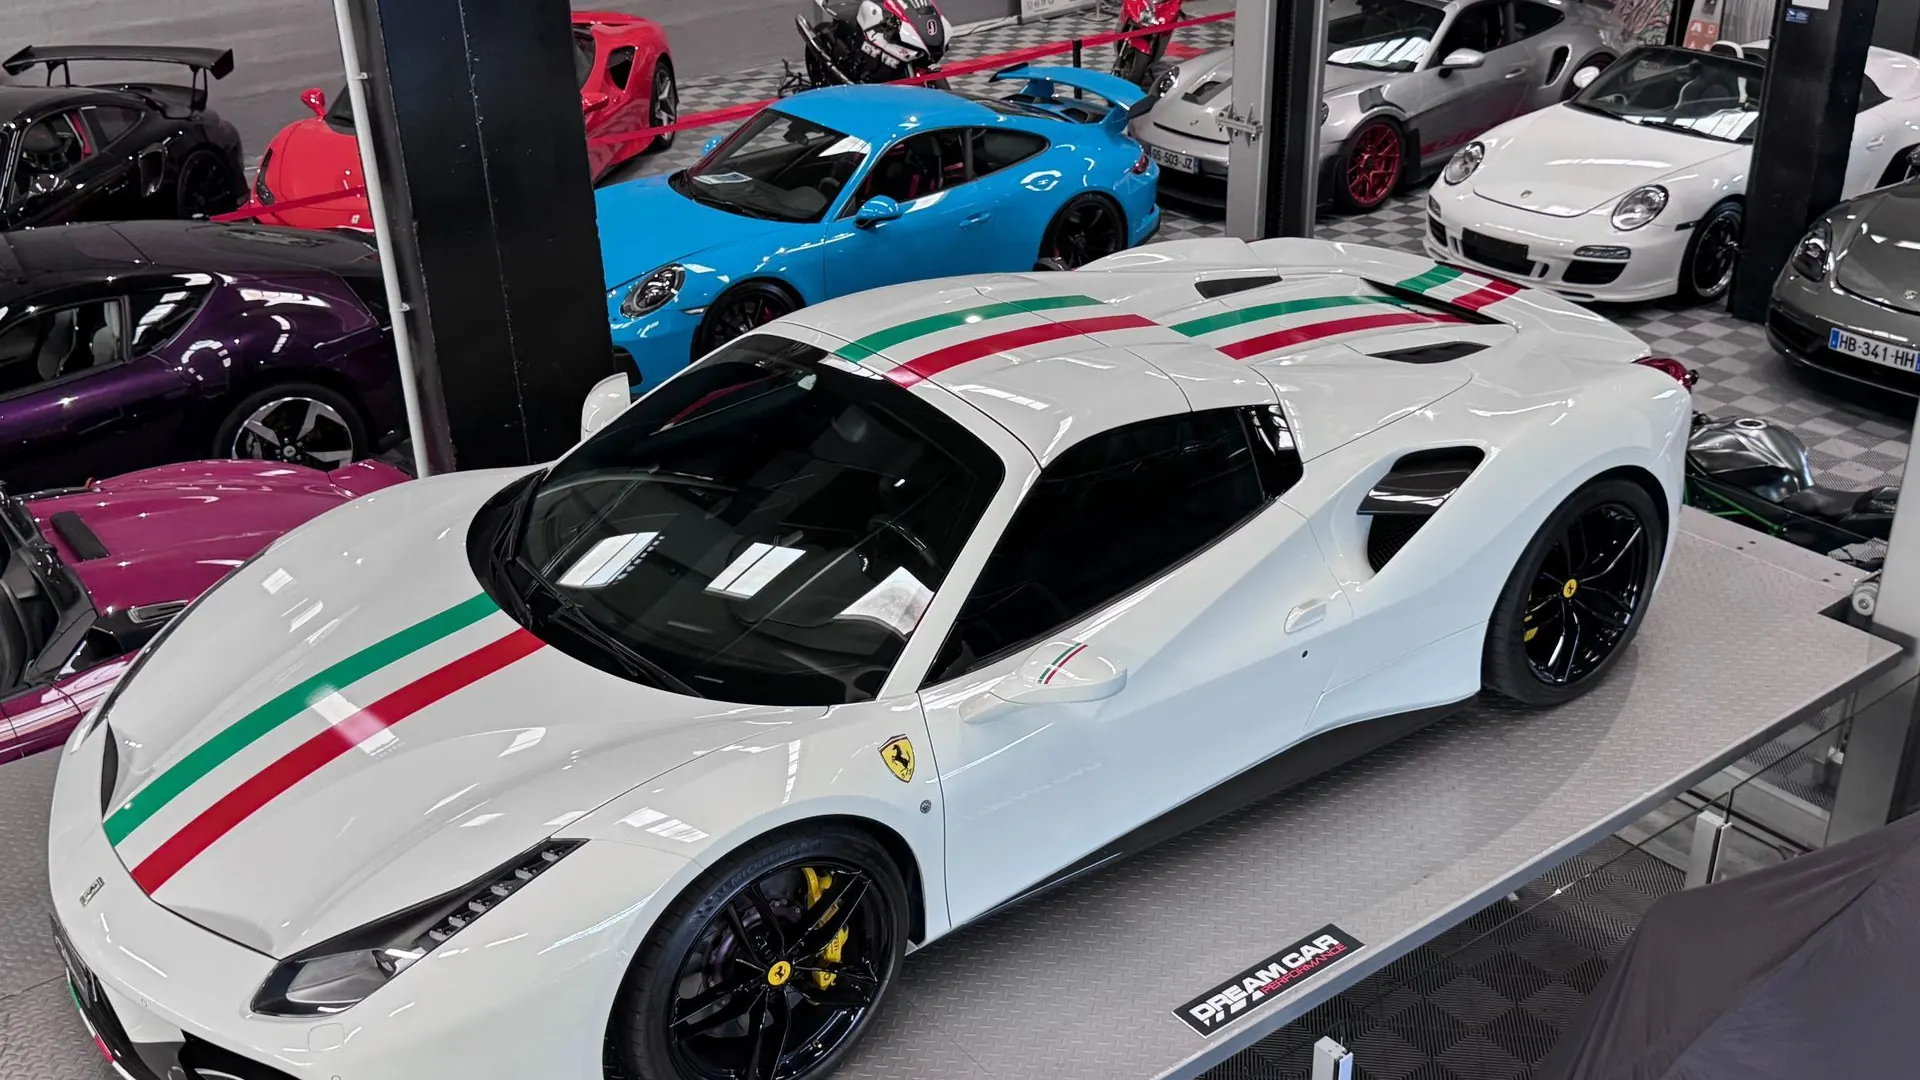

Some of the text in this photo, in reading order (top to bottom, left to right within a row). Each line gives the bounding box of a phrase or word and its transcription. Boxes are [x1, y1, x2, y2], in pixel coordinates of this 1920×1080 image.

[1839, 334, 1916, 368] HB-341-HH
[1188, 934, 1341, 1025] DREAM CAR
[1260, 943, 1348, 994] PERFORMANCE
